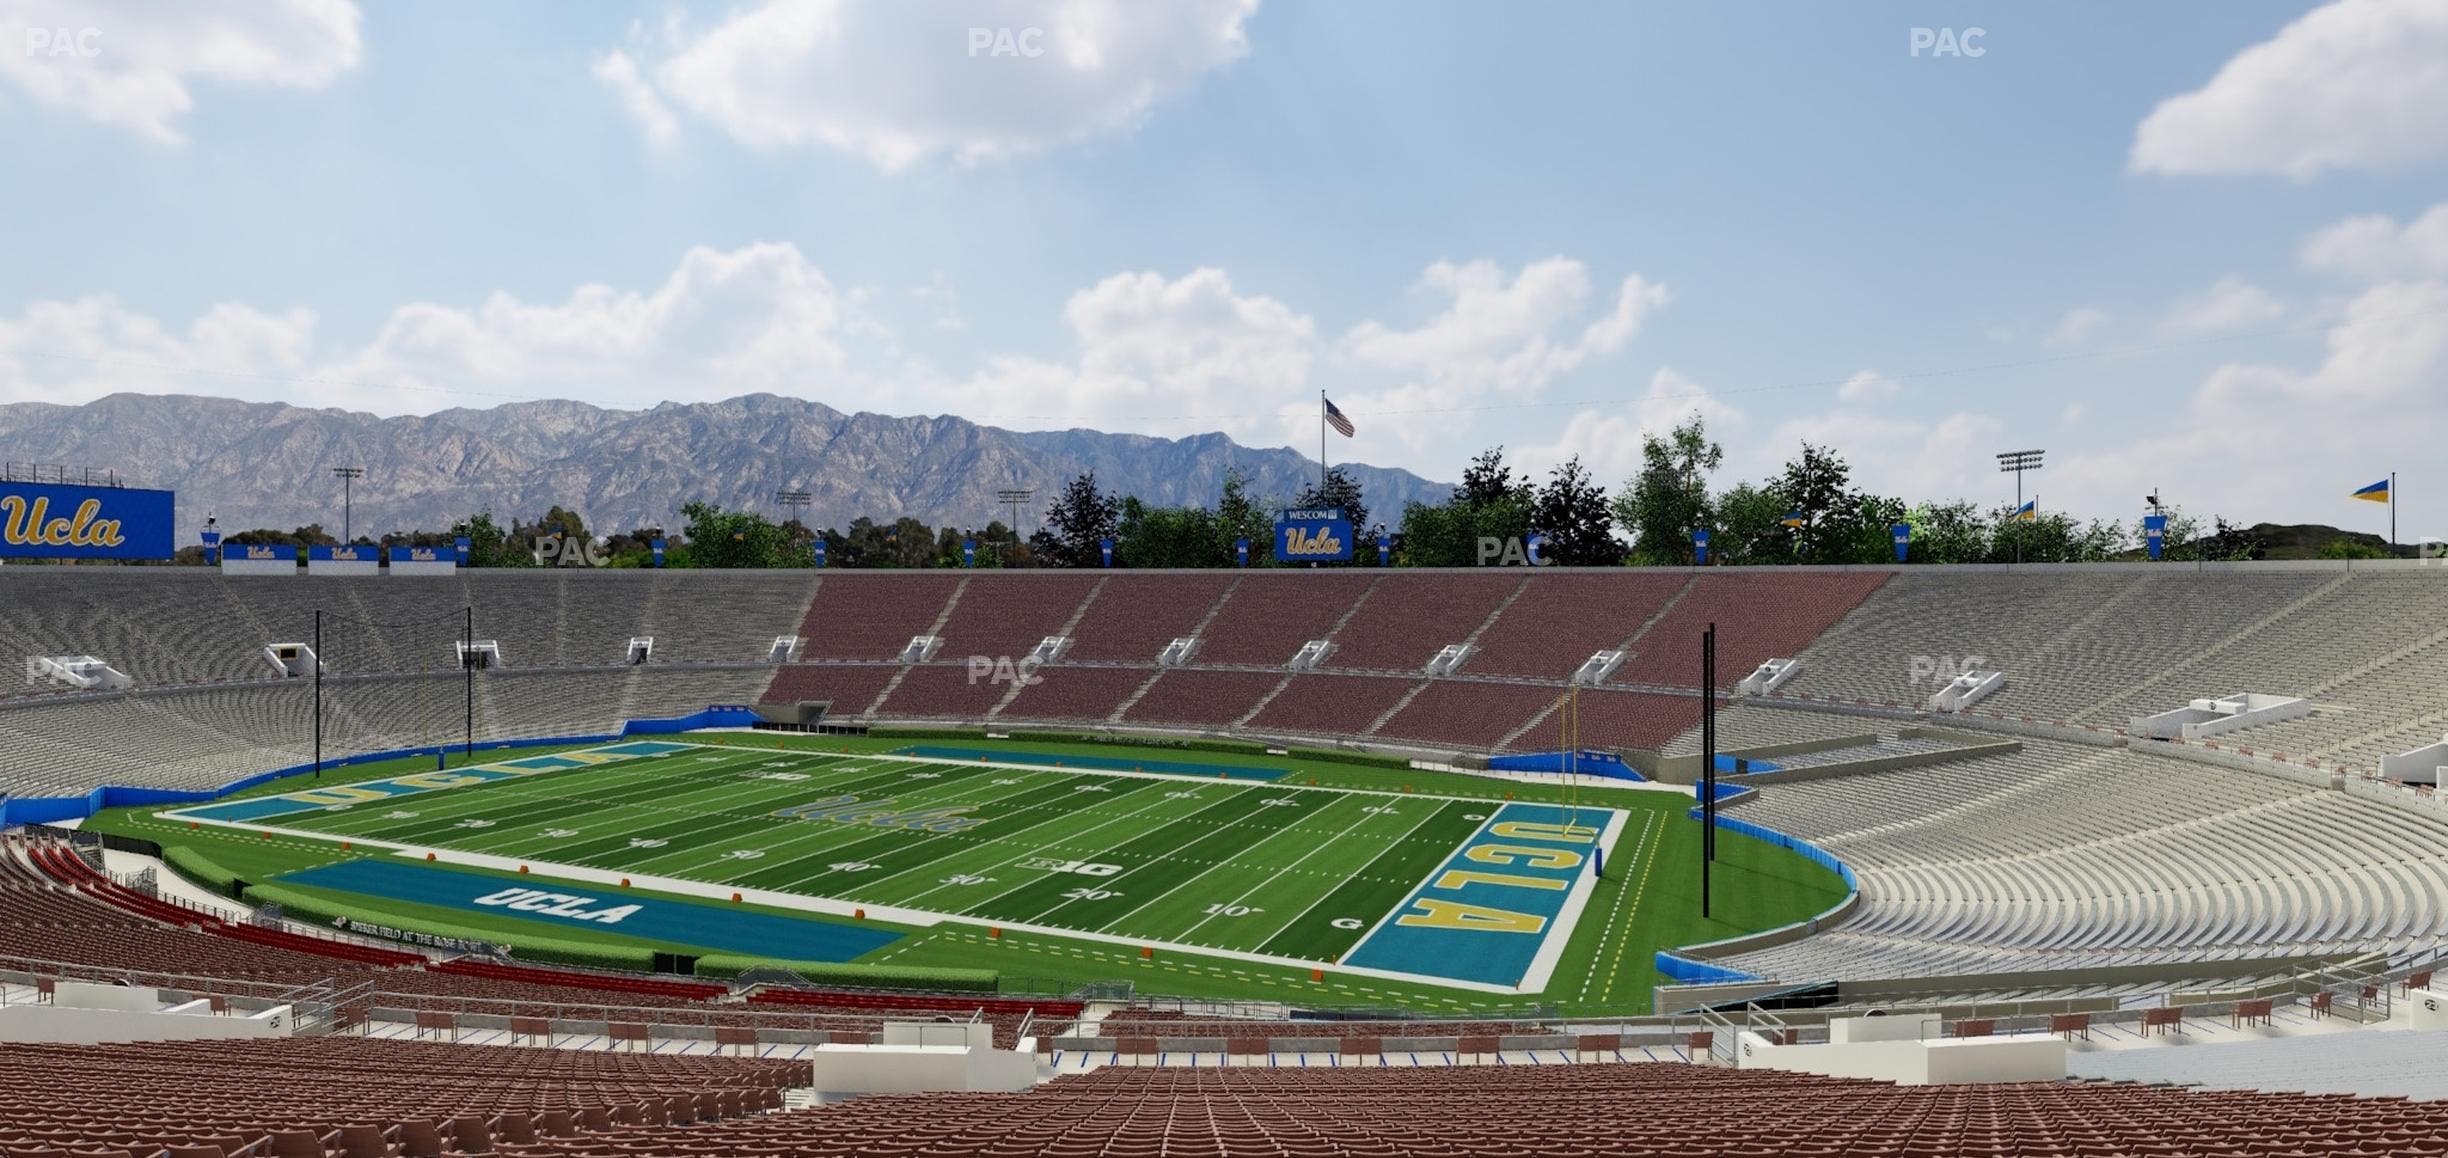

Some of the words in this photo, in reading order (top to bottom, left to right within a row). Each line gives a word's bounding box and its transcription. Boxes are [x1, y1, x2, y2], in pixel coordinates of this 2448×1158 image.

[1, 495, 125, 547] Ucla
[1289, 511, 1327, 520] WESCOM
[1285, 527, 1341, 555] Ucla
[939, 874, 986, 886] 30
[1394, 821, 1600, 934] UCLA
[1060, 888, 1111, 901] 20
[473, 887, 644, 924] UCLA
[1202, 903, 1250, 917] 10
[1331, 917, 1364, 930] G
[402, 931, 414, 942] AT
[415, 932, 433, 945] THE
